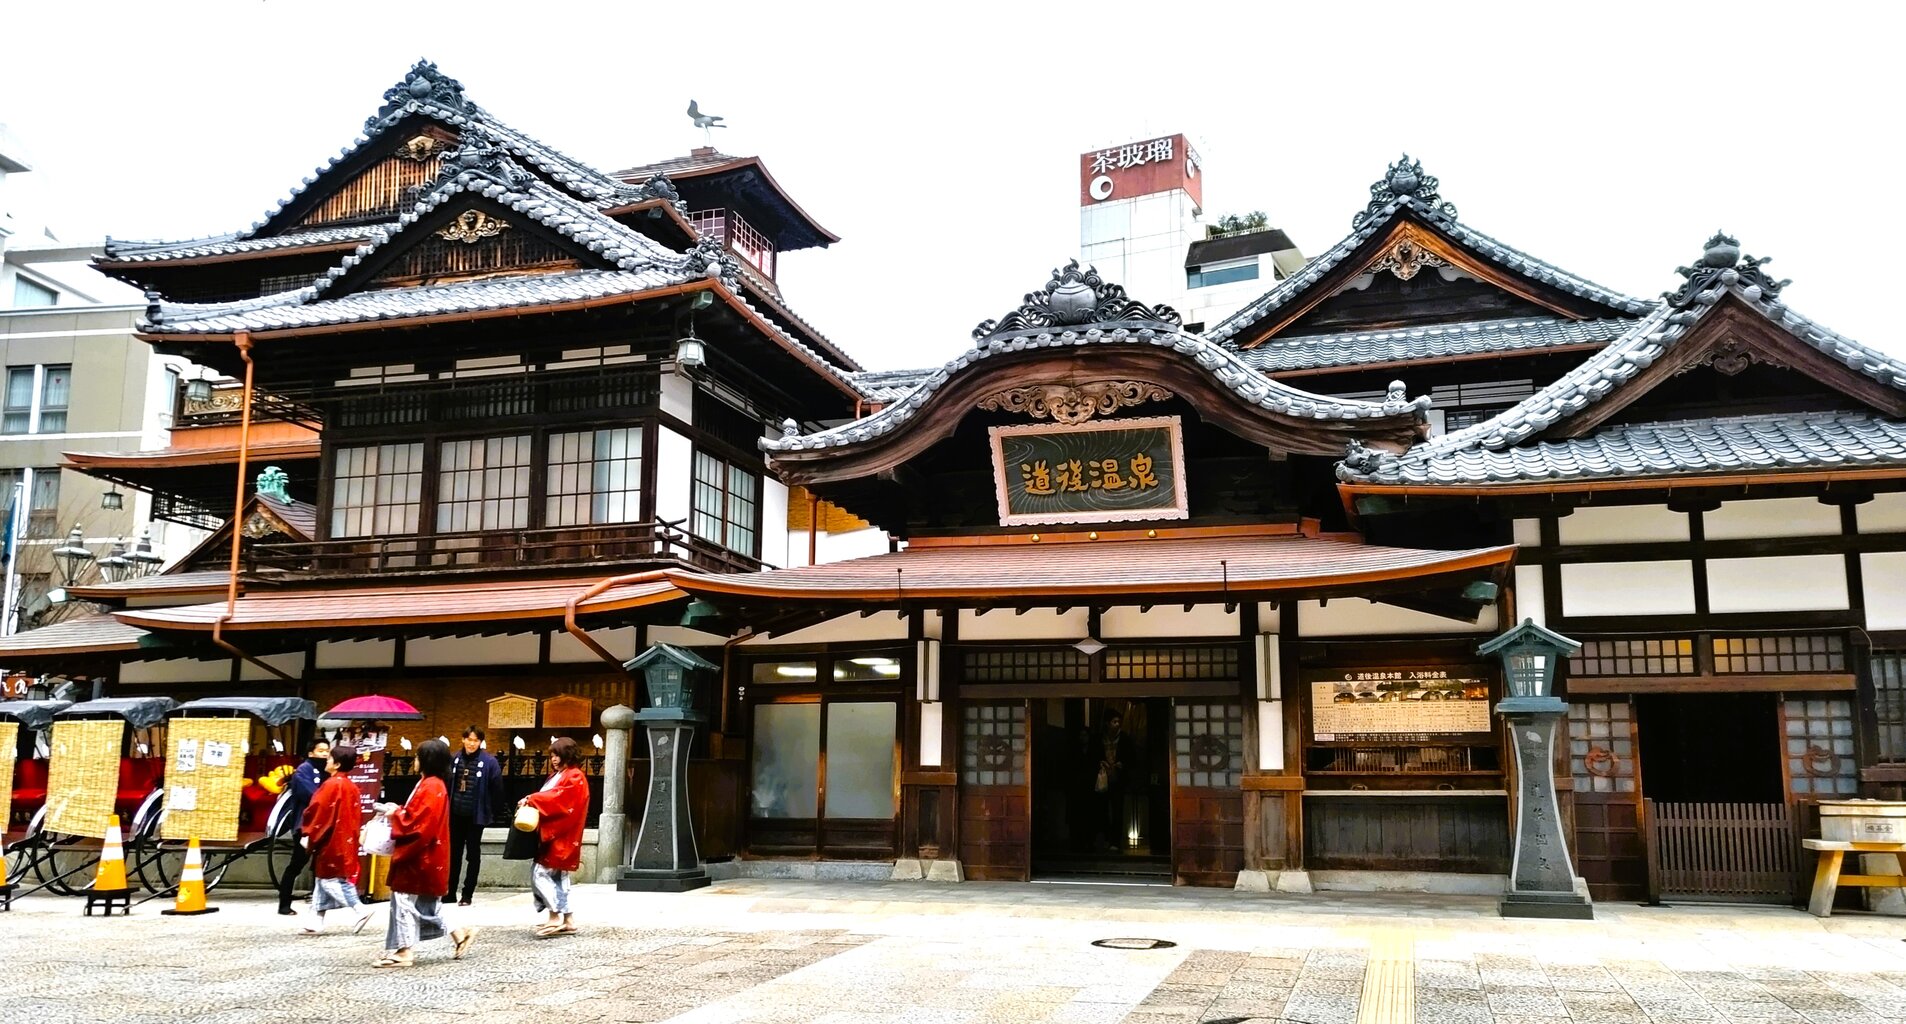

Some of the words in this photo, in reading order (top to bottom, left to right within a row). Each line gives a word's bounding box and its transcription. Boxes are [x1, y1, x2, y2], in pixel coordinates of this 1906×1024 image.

[1089, 138, 1173, 174] 茶玻瑠
[1021, 452, 1159, 496] 道後温泉
[1357, 671, 1402, 681] 道後温泉本館
